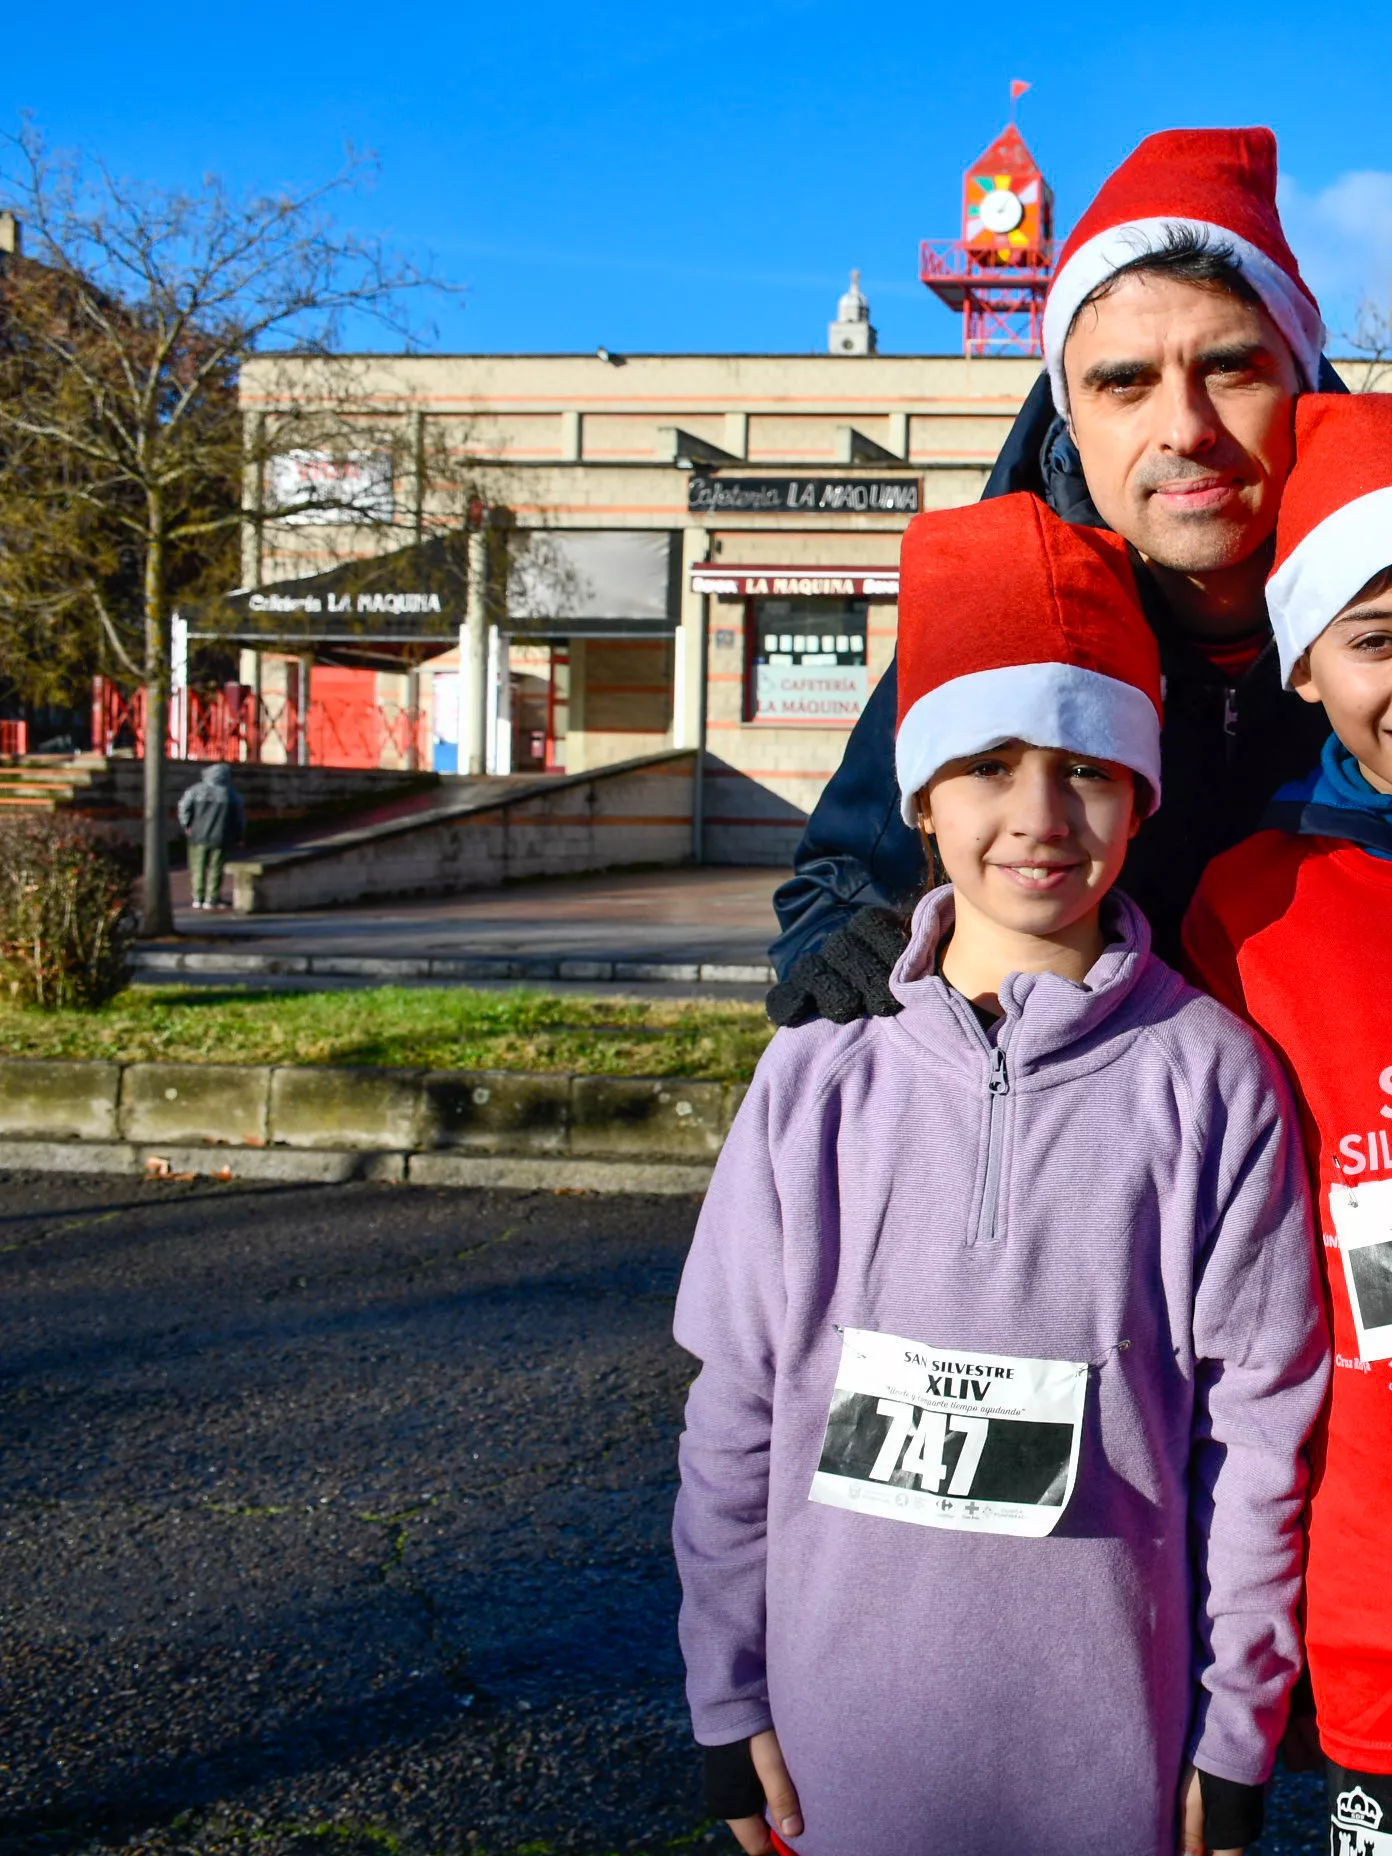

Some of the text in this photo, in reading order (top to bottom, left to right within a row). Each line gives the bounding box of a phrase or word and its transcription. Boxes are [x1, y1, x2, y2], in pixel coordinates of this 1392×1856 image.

[787, 481, 816, 507] LA
[745, 578, 769, 595] LA
[773, 578, 855, 596] MAQUINA
[327, 592, 351, 612] LA
[904, 1351, 1015, 1379] SAN SILVESTRE
[1335, 1353, 1352, 1369] Cruz
[926, 1374, 992, 1402] XLIV
[950, 1400, 978, 1412] tiempo
[868, 1398, 989, 1496] 747
